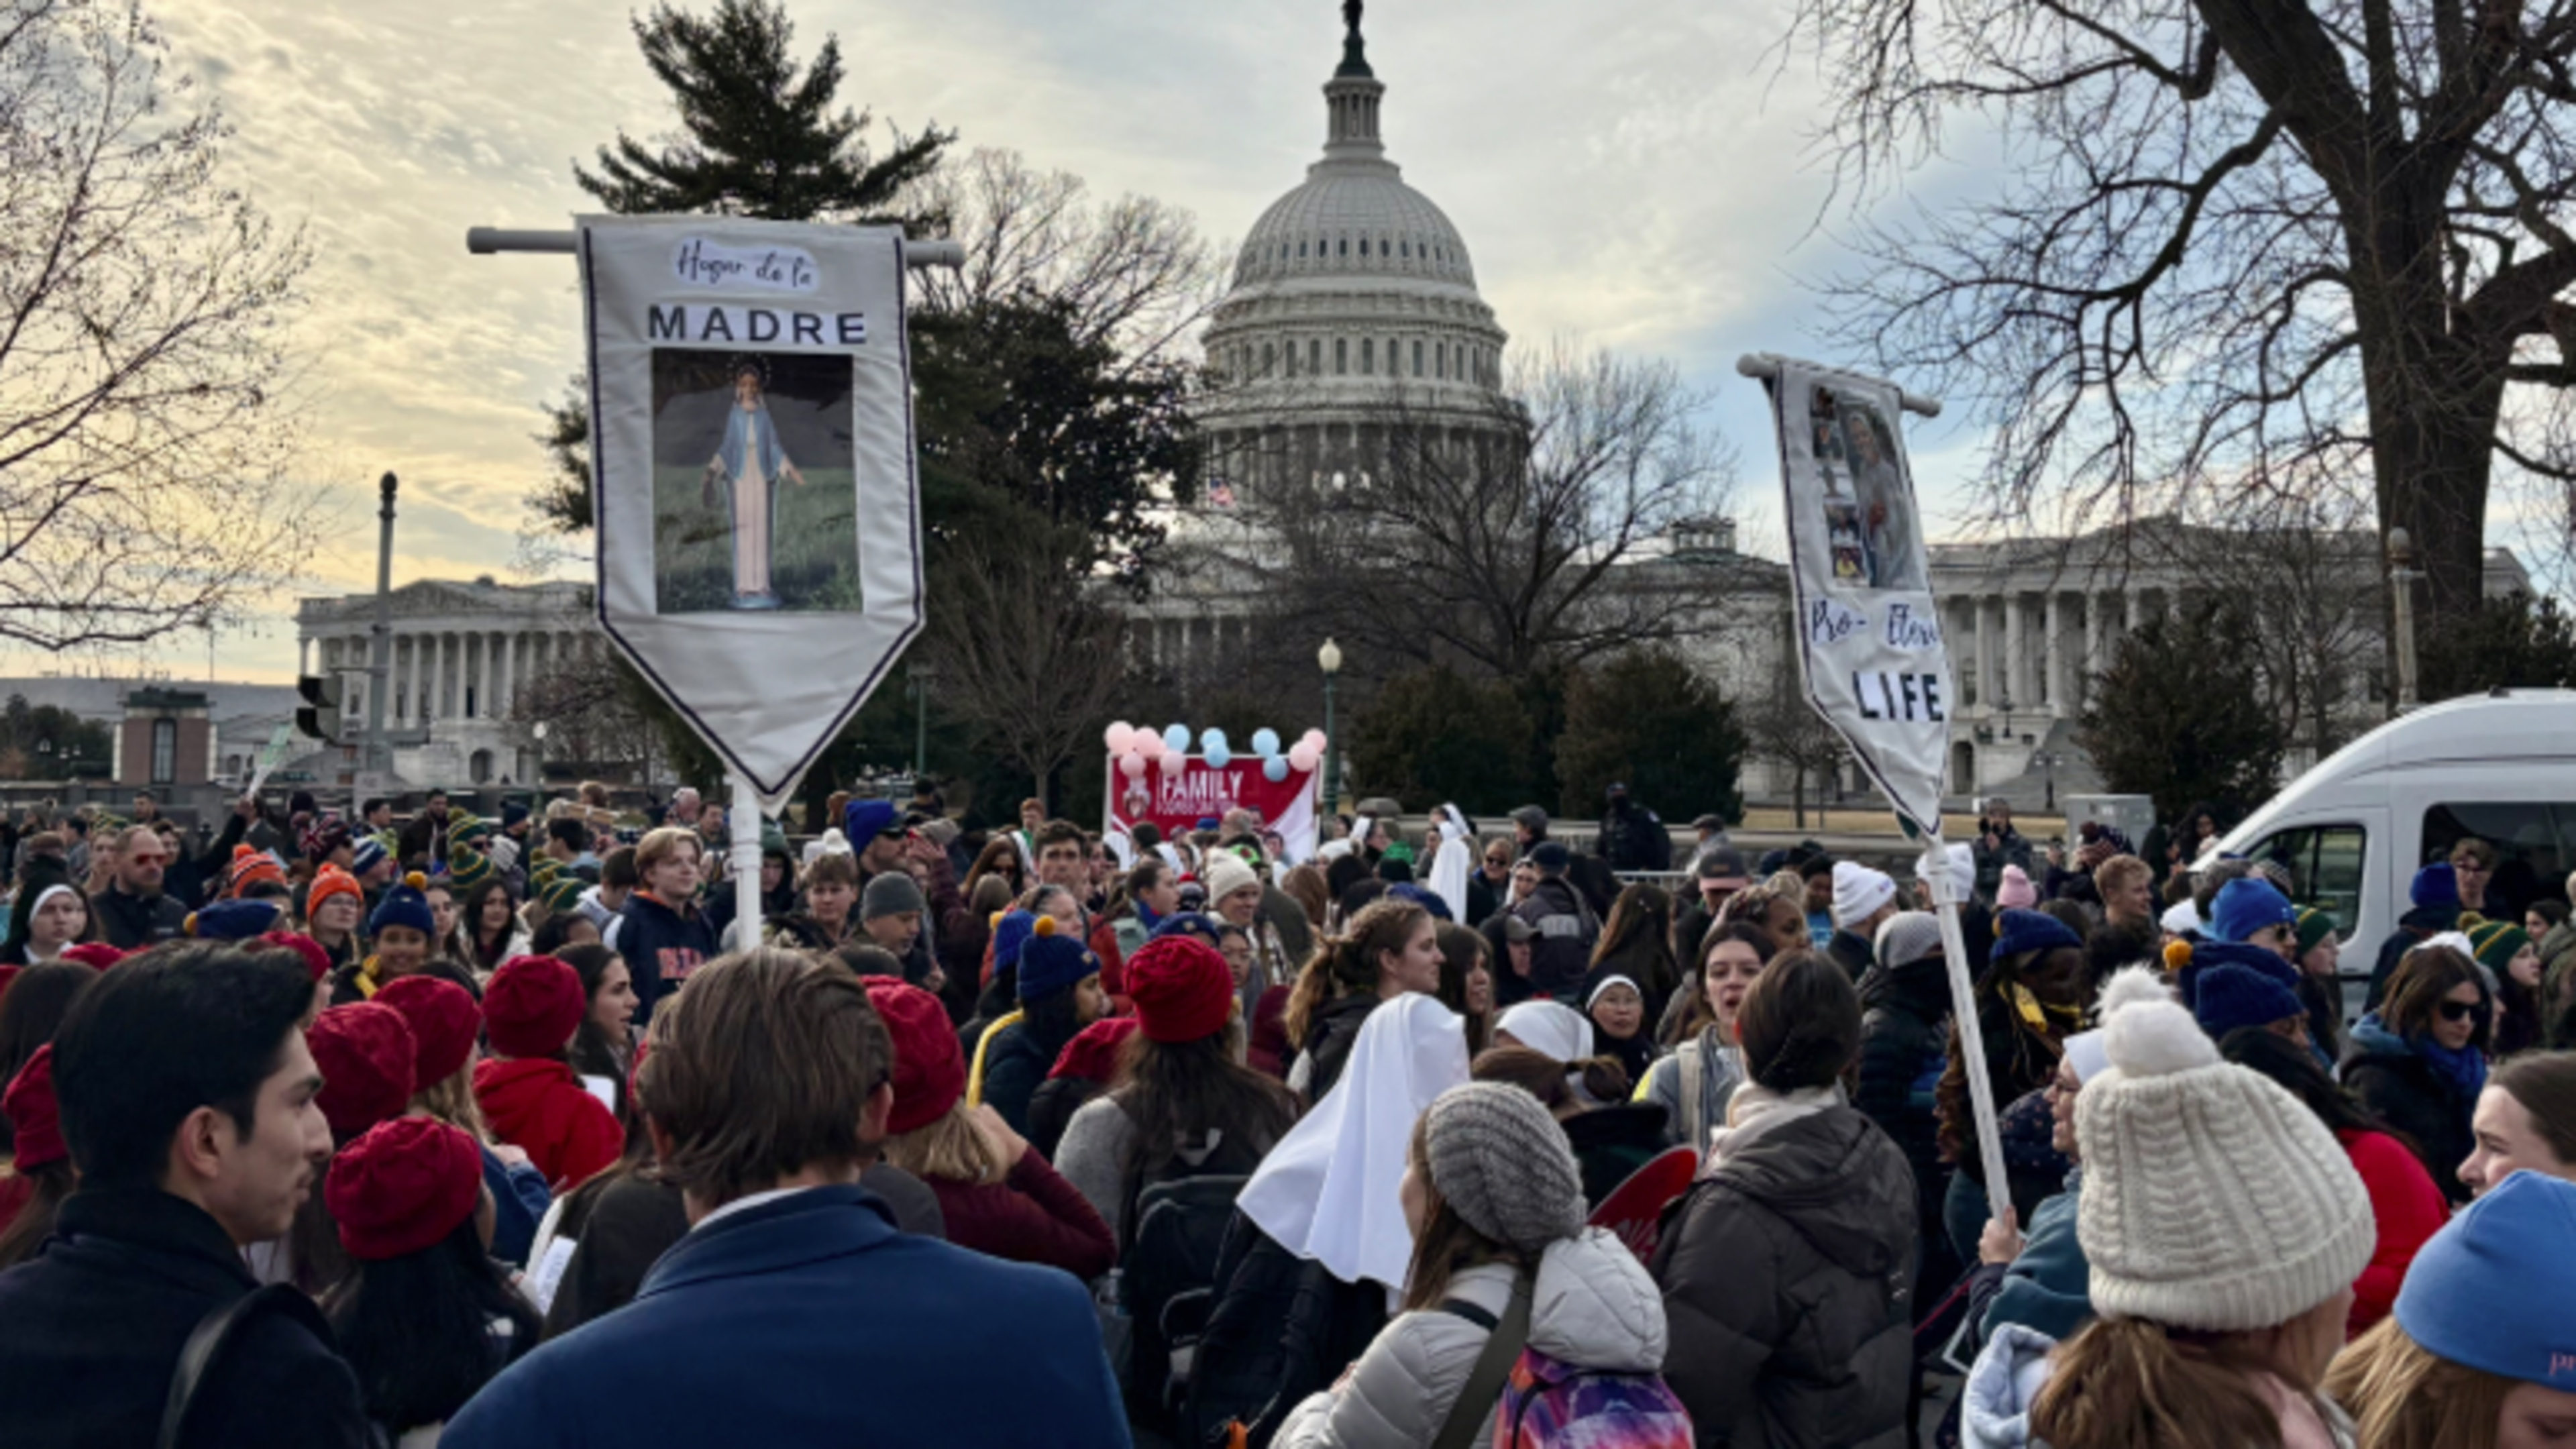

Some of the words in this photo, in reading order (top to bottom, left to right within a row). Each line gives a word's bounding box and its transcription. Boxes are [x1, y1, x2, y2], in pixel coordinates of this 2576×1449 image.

[678, 239, 747, 284] Hogar
[755, 251, 784, 282] de
[792, 256, 811, 288] la
[649, 305, 867, 344] MADRE
[1852, 671, 1943, 722] LIFE
[1162, 771, 1244, 800] FAMILY
